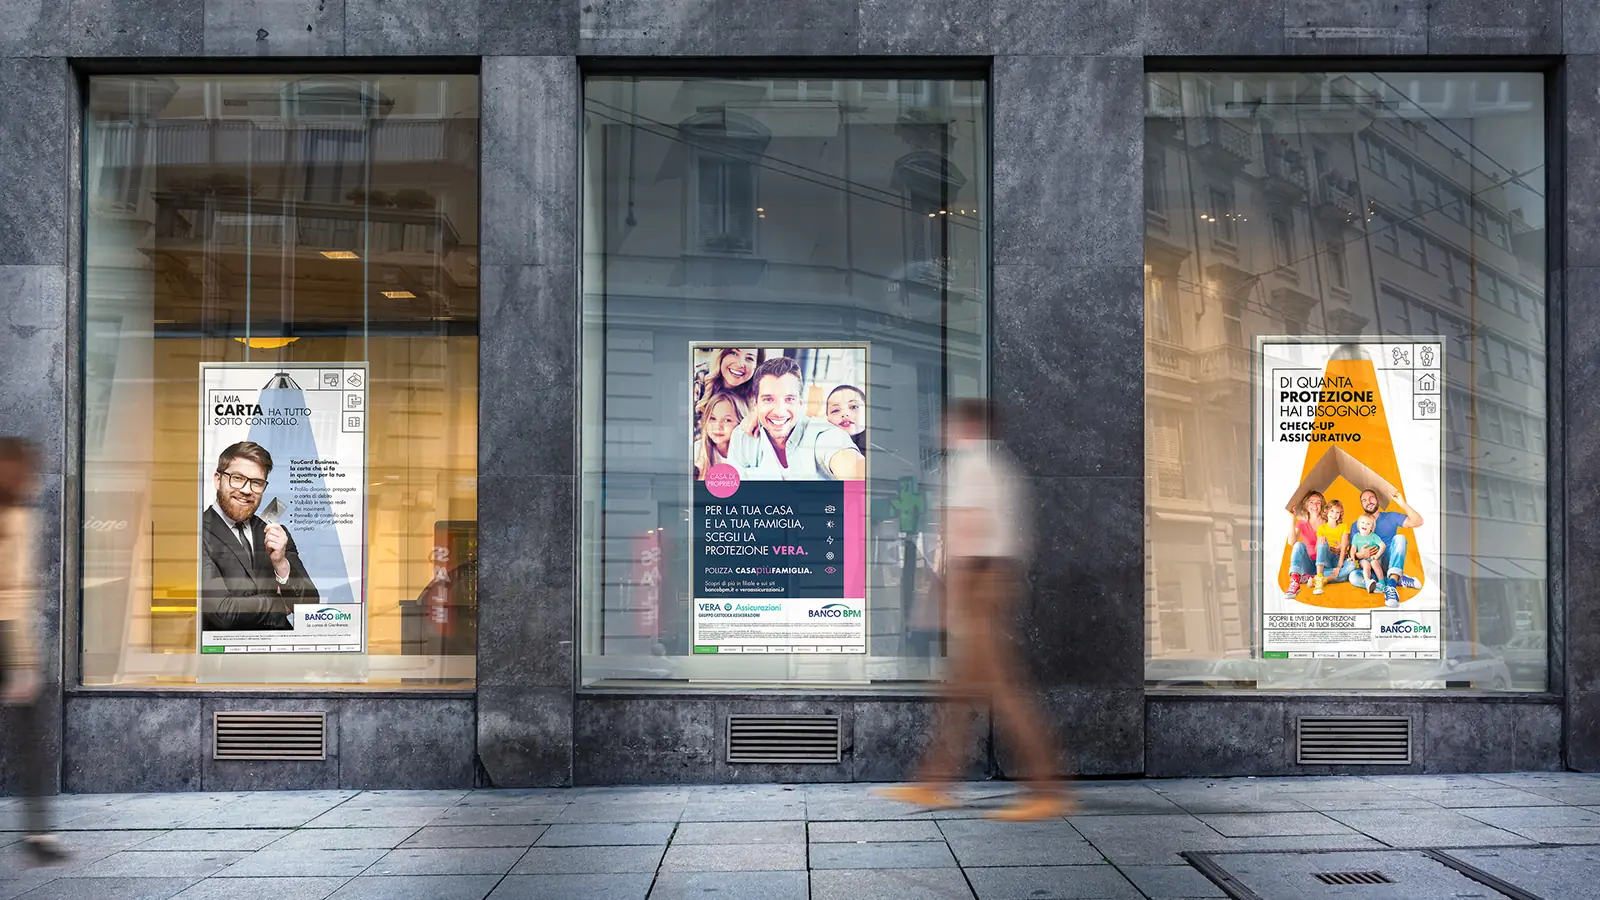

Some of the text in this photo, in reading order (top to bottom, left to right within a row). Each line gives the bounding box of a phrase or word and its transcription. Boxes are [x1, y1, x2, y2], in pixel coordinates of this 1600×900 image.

[1280, 377, 1353, 388] DI QUANTA
[1280, 391, 1373, 402] PROTEZIONE
[214, 404, 312, 416] CARTA HA TUTTO
[1280, 405, 1377, 417] HAI BISOGNO?
[214, 418, 299, 426] SOTTO CONTROLLO.
[1280, 422, 1335, 430] CHECK-UP
[1280, 433, 1361, 442] ASSICURATIVO
[705, 505, 793, 515] PER LA TUA CASA
[83, 516, 128, 532] ione
[705, 519, 805, 530] E LA TUA FAMIGLIA,
[705, 532, 756, 542] SCEGLI LA
[705, 546, 809, 556] PROTEZIONE VERA.
[808, 610, 862, 618] BANCO BPM
